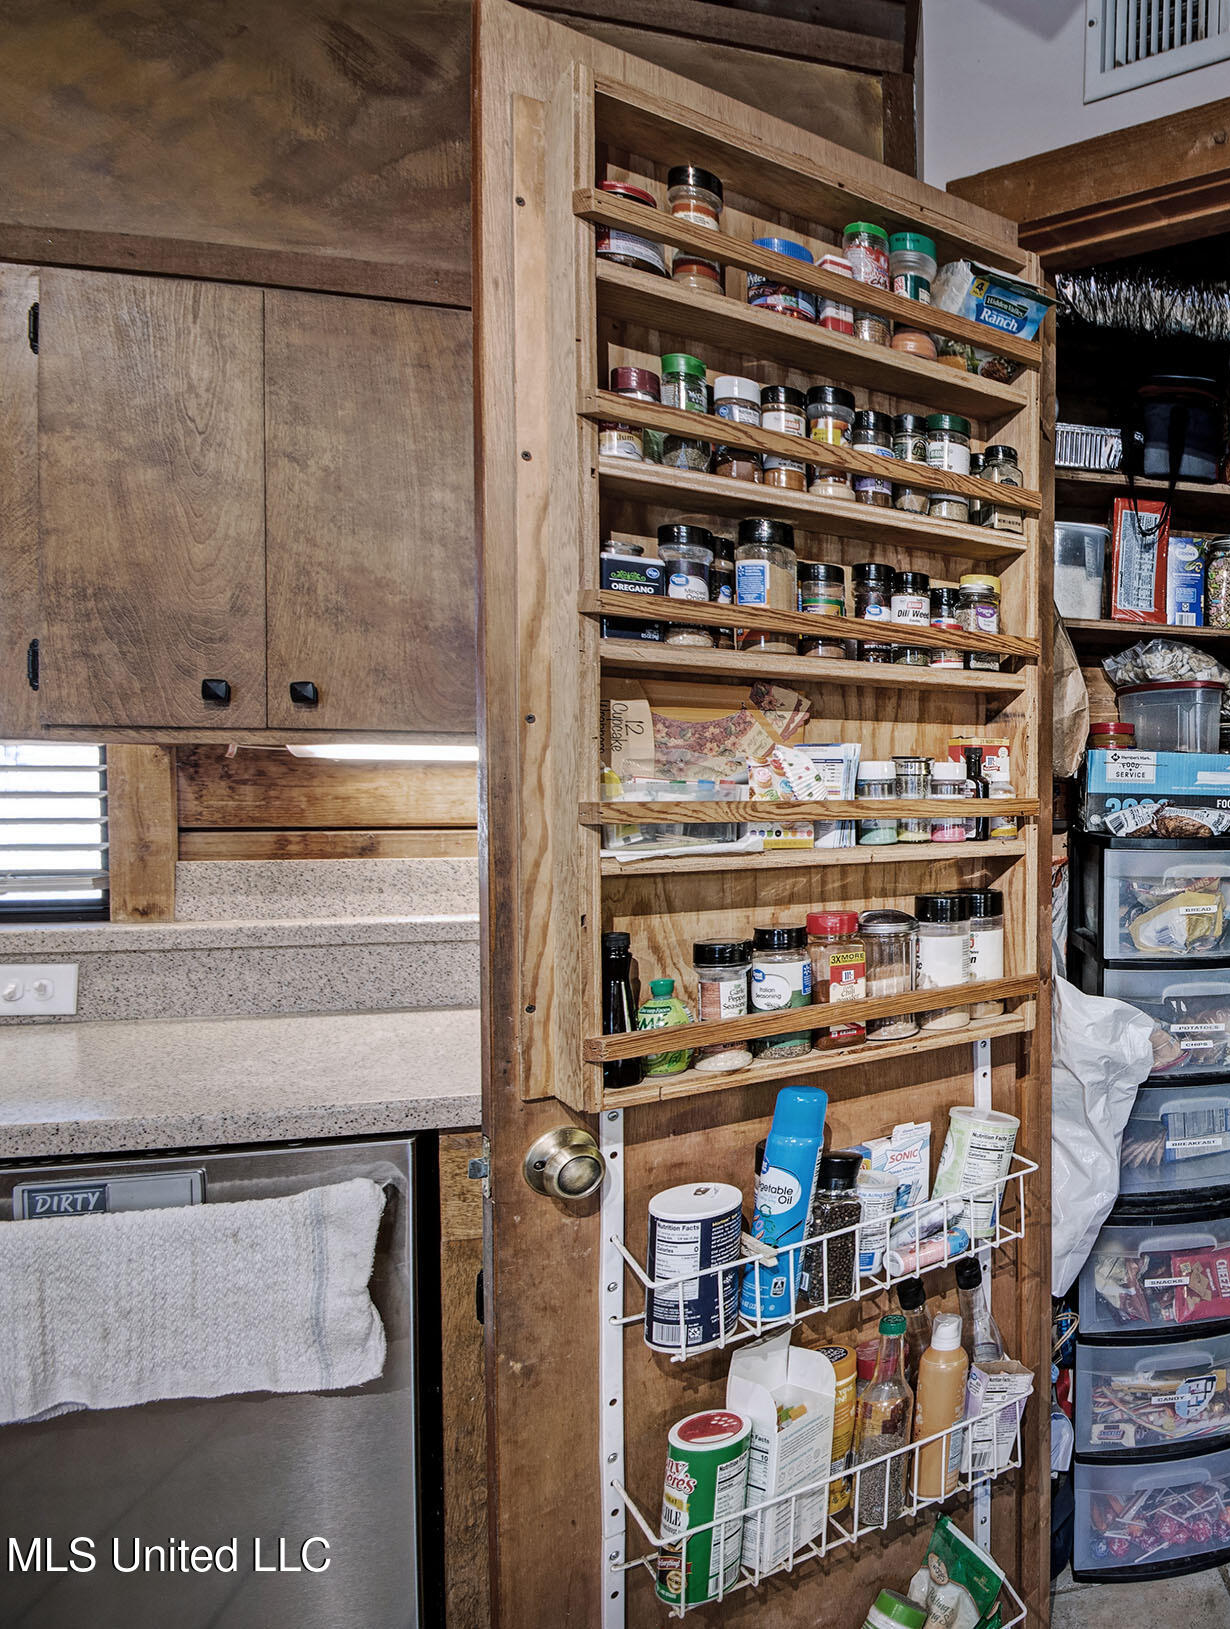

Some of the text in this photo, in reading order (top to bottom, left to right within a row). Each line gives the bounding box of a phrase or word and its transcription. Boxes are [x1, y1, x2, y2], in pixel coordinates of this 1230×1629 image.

[975, 281, 985, 292] 4
[986, 297, 1025, 318] Hidden Valley
[980, 307, 1019, 332] Ranch
[611, 582, 655, 594] OREGANO
[897, 609, 910, 618] Dill
[612, 703, 628, 753] Cupcake
[625, 720, 645, 736] 12
[830, 952, 865, 965] 3X MORE
[755, 992, 782, 1000] Seasoning
[1171, 1139, 1216, 1147] BREAKFAST
[888, 1148, 919, 1164] SONIC
[759, 1180, 794, 1196] getable
[34, 1192, 100, 1213] DIRTY
[777, 1195, 793, 1205] Oil
[657, 1222, 700, 1232] Nutrition Facts
[1150, 1278, 1184, 1286] SNACKS
[760, 1454, 769, 1462] 10
